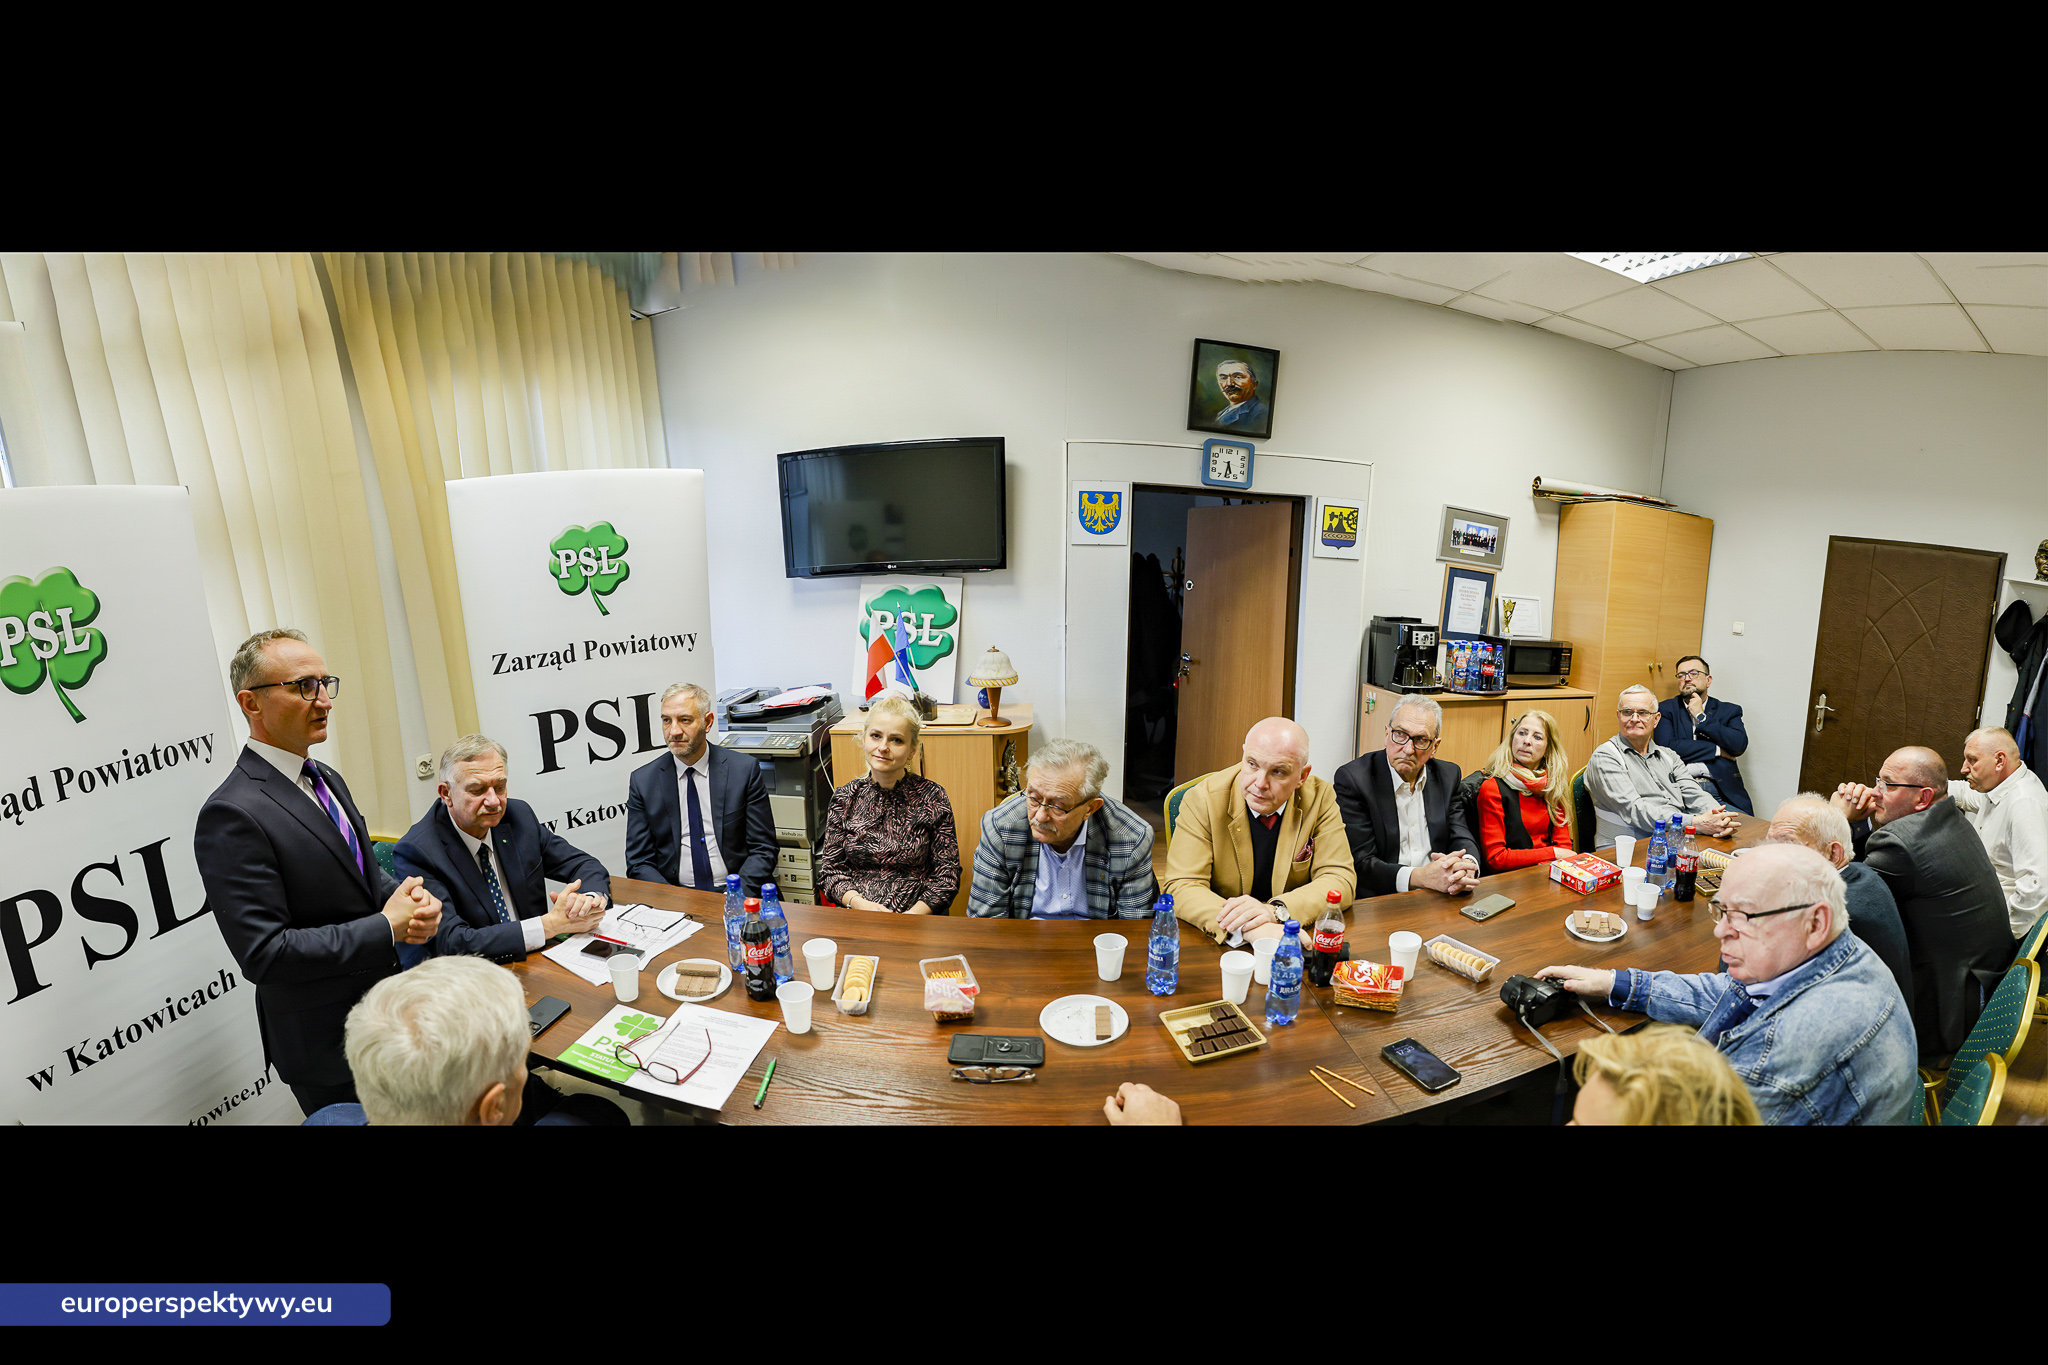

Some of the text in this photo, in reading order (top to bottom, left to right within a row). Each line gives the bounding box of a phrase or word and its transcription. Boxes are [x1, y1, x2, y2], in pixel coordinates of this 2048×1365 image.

[556, 545, 620, 580] PSL
[0, 607, 91, 667] PSL
[491, 632, 698, 676] Zarząd Powiatowy
[872, 610, 944, 647] PSL
[528, 692, 669, 776] PSL
[0, 732, 214, 826] ąd Powiatowy
[540, 803, 629, 834] w Katow
[0, 836, 212, 1006] PSL
[26, 968, 238, 1092] w Katowicach
[590, 1052, 617, 1064] STATUT
